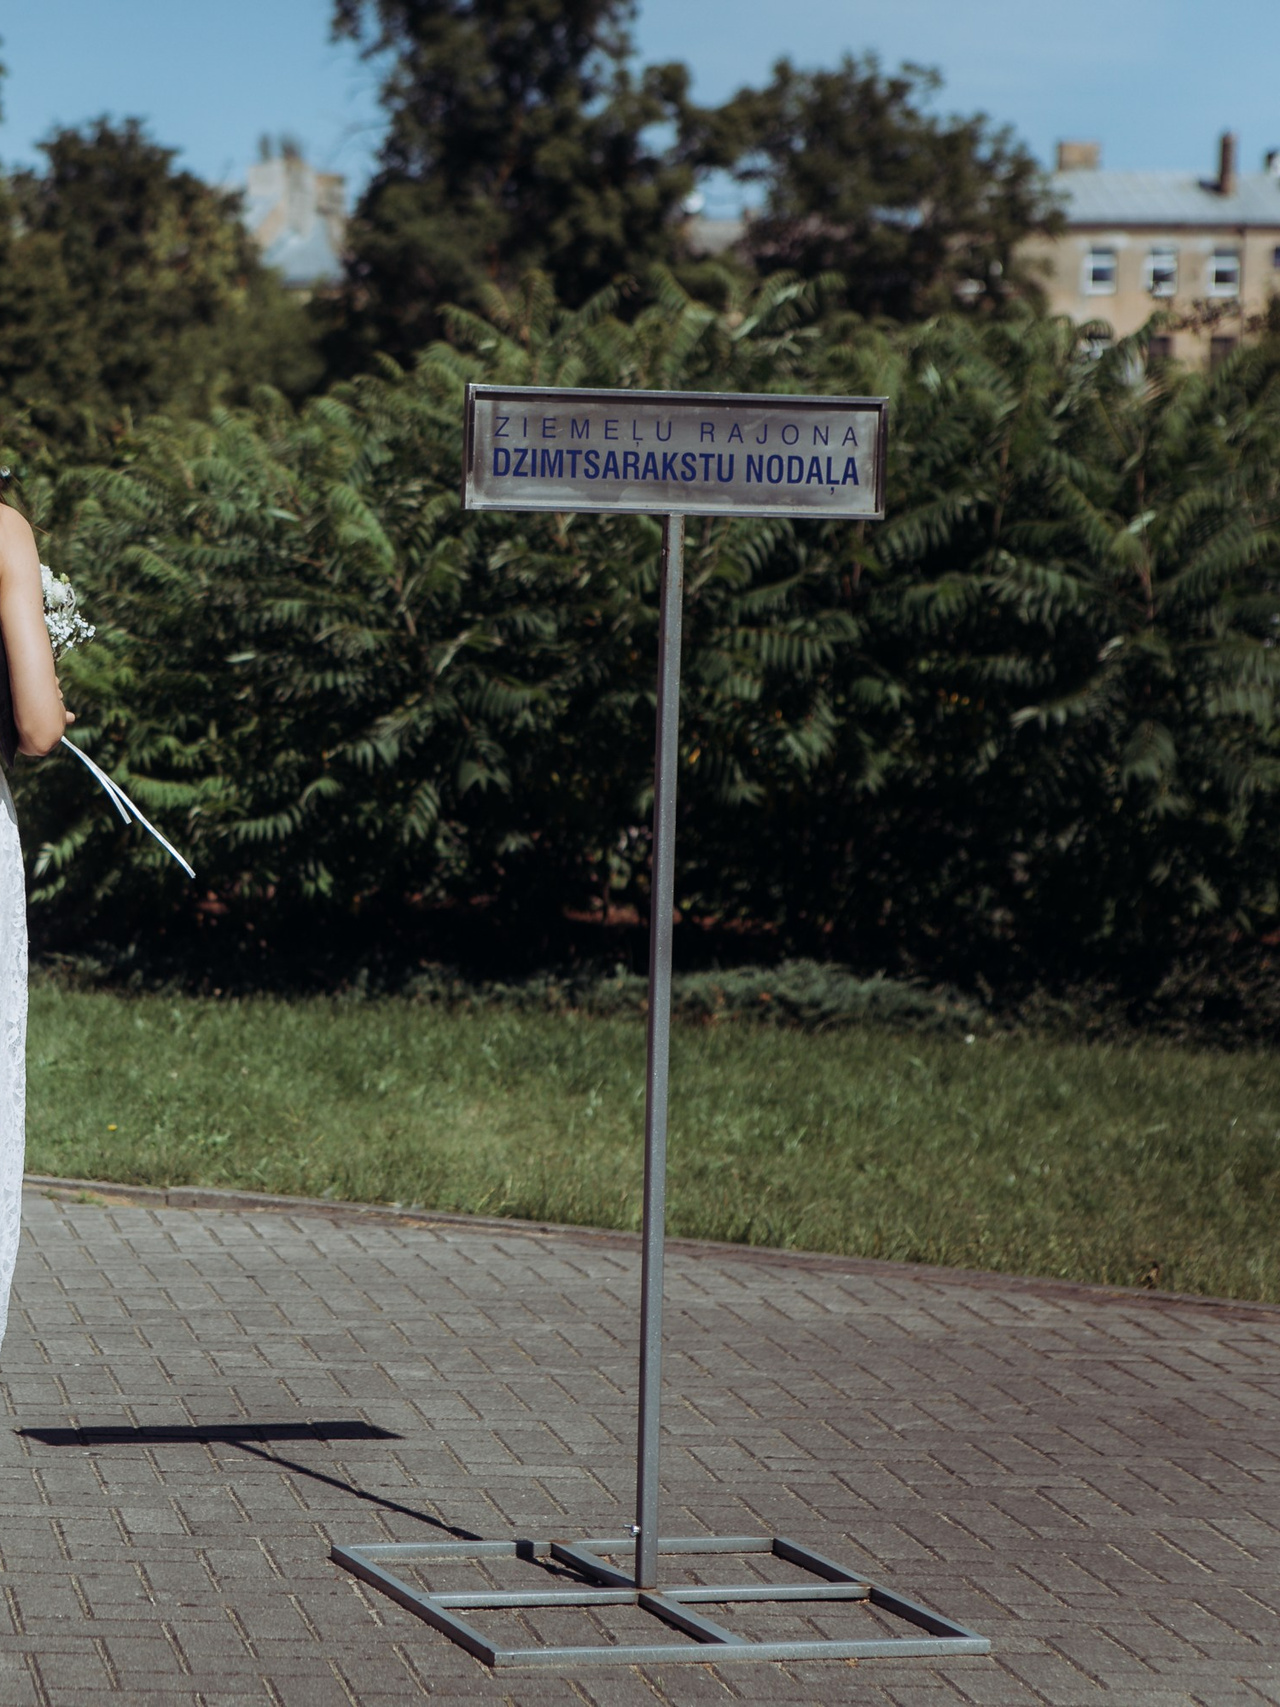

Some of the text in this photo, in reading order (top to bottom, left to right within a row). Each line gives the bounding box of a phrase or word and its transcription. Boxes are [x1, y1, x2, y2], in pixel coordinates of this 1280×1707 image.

[494, 416, 858, 447] ZIEMEĻU RAJONA
[493, 448, 859, 495] DZIMTSARAKSTU NODAĻA
